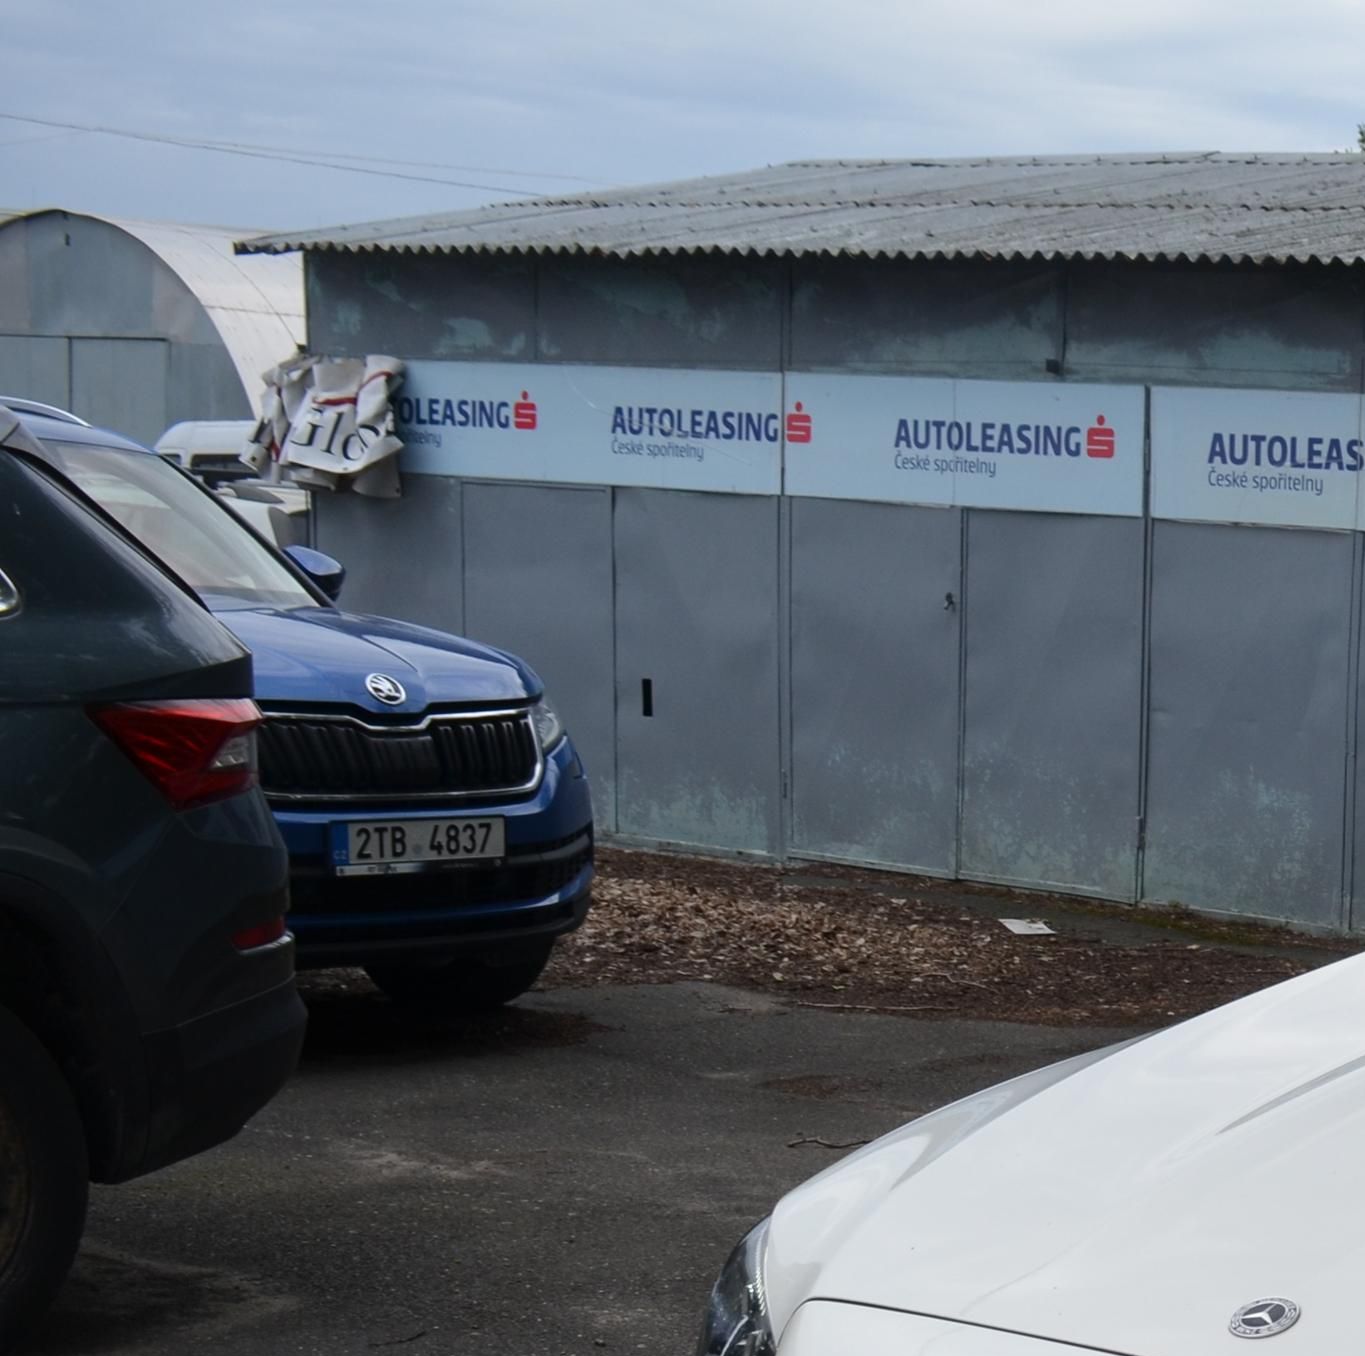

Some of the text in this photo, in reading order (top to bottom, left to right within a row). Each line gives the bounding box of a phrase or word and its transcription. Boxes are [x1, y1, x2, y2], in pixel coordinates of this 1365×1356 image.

[399, 397, 510, 429] OLEASING
[611, 406, 779, 443] AUTOLEASING
[894, 418, 1081, 457] AUTOLEASING
[894, 450, 930, 471] České
[1208, 466, 1324, 496] České spořitelny
[356, 822, 492, 860] 2TB 4837
